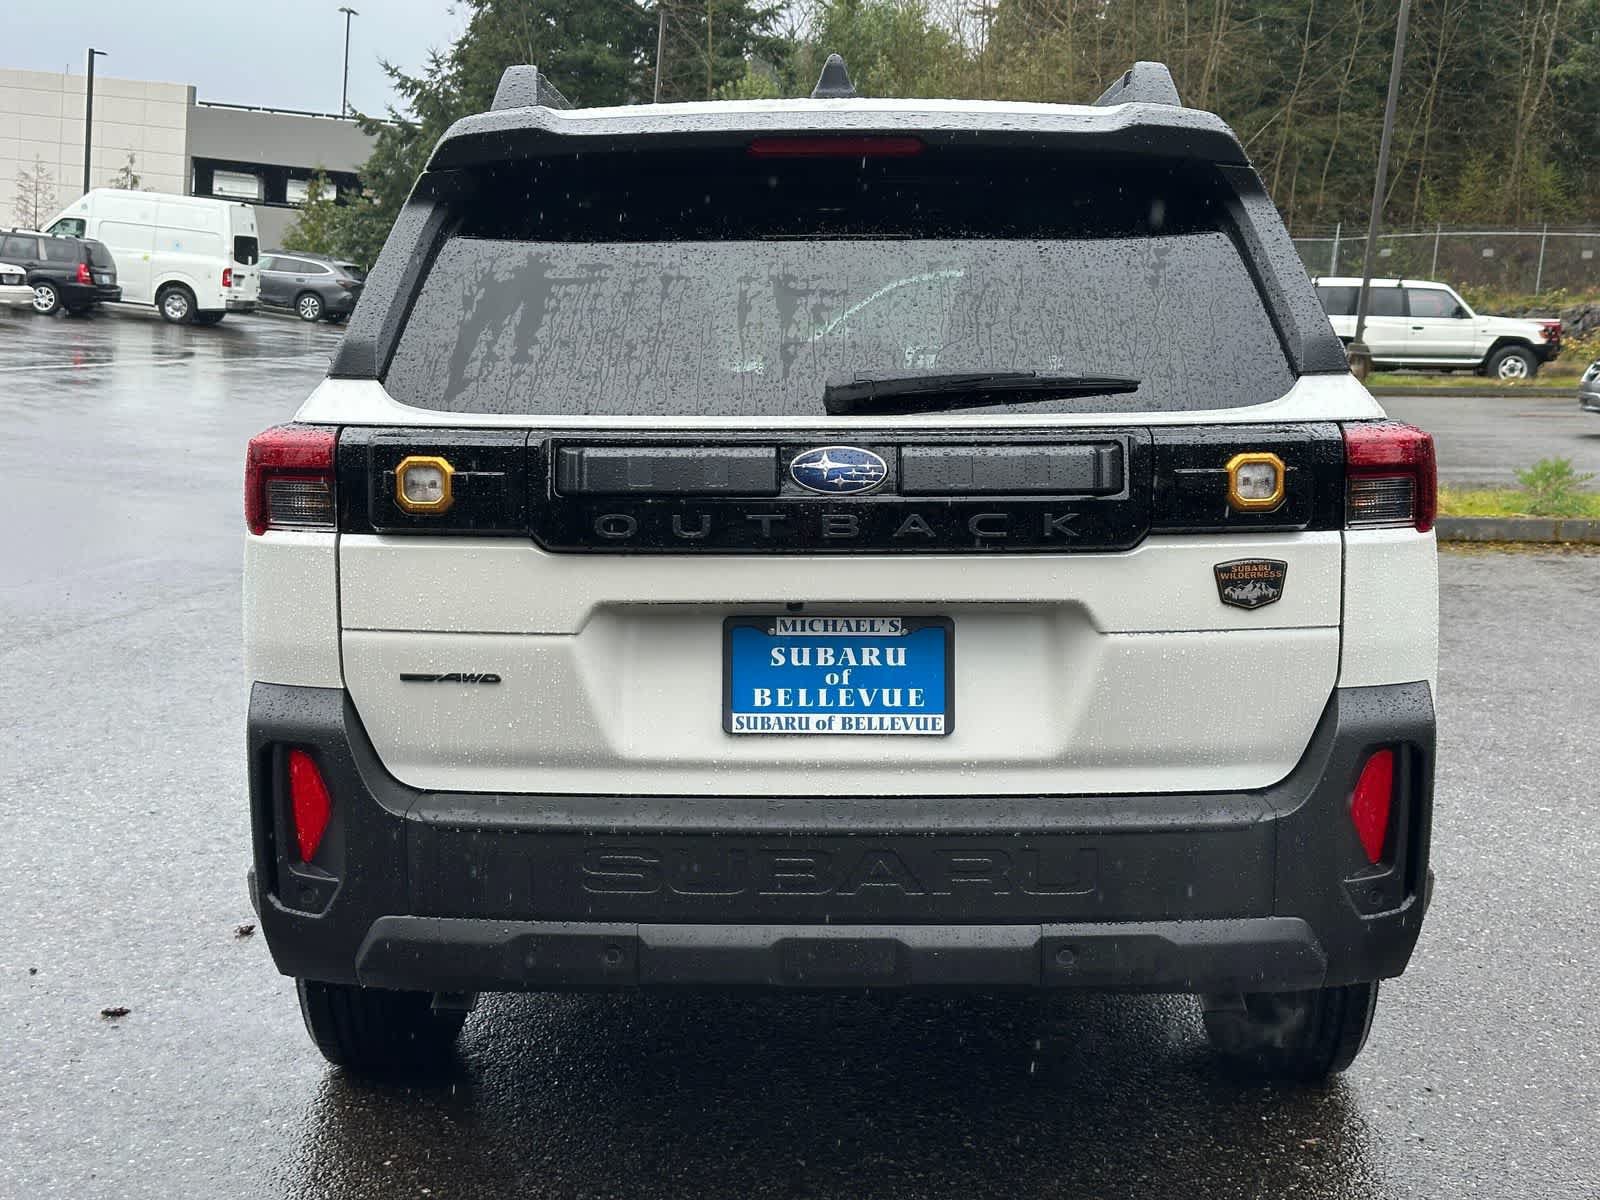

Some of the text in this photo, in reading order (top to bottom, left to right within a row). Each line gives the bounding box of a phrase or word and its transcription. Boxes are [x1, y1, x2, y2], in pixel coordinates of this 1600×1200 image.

[597, 513, 1081, 538] OUTBACK
[1220, 570, 1282, 580] WILDERNESS
[1231, 564, 1271, 572] SUBARU
[778, 618, 901, 633] MICHAEL'S
[770, 647, 908, 667] SUBARU
[438, 673, 501, 683] AWD
[825, 668, 852, 686] of
[752, 688, 926, 707] BELLEVUE
[735, 714, 942, 731] SUBARU of BELLEVUE
[580, 846, 1098, 897] SUBARU
